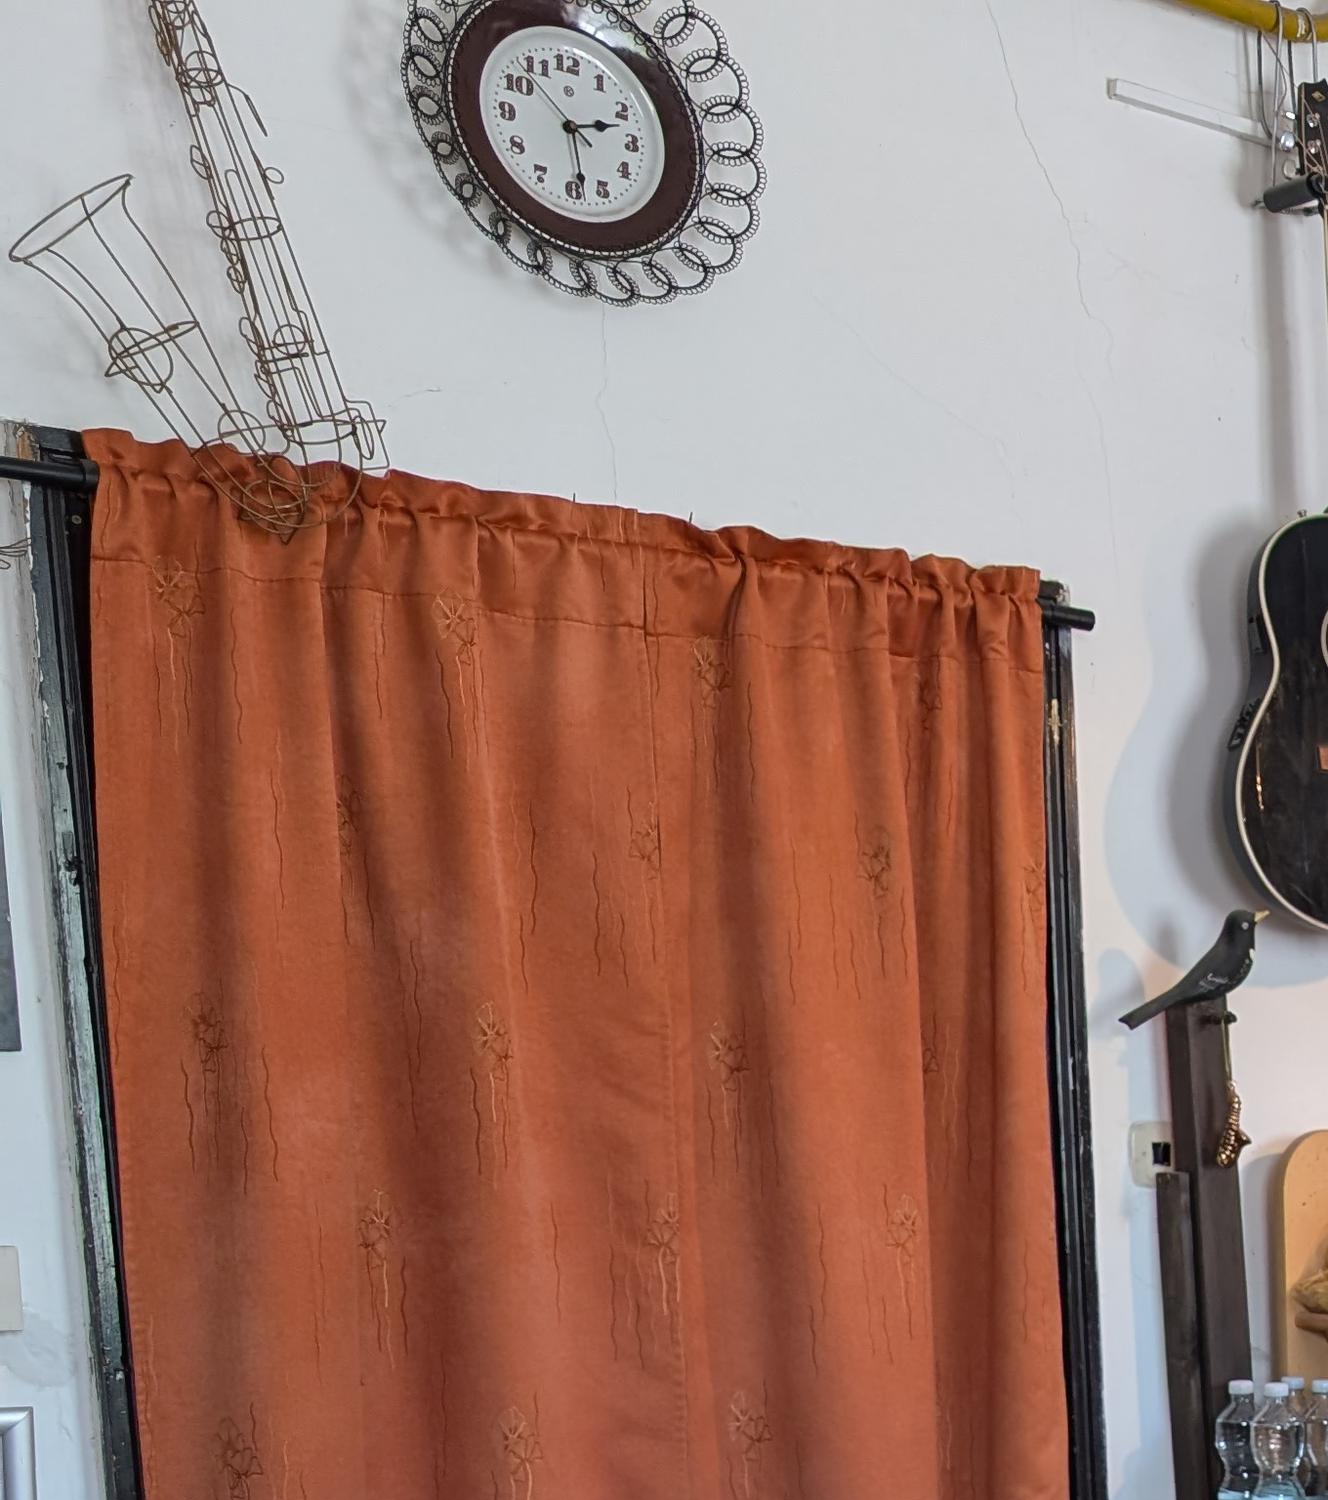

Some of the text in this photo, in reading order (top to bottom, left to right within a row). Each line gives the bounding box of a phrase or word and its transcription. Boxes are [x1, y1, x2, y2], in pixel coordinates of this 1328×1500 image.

[522, 55, 552, 79] 11
[553, 53, 581, 77] 12
[503, 73, 534, 97] 10
[593, 73, 608, 94] 1
[498, 101, 517, 122] 9
[615, 101, 630, 122] 2
[510, 135, 526, 156] 8
[624, 133, 640, 153] 3
[533, 164, 548, 184] 7
[617, 162, 632, 181] 4
[565, 181, 582, 201] 6
[595, 180, 610, 200] 5
